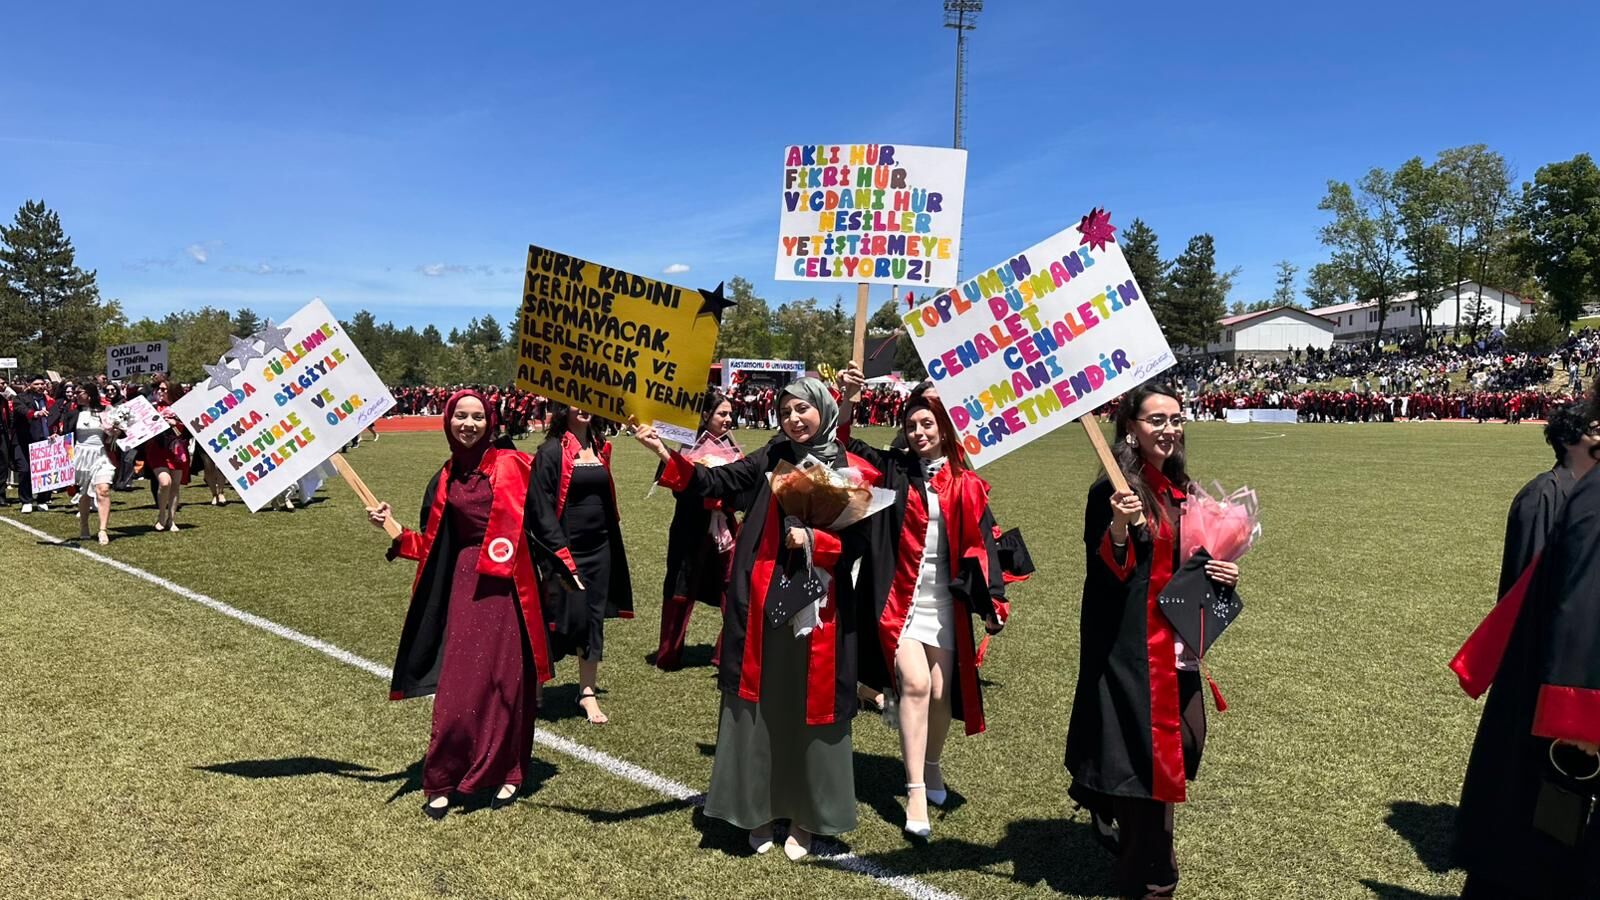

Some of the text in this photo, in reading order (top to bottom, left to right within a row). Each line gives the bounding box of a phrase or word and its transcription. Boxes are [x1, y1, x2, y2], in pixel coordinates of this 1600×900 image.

[786, 144, 899, 166] AKLI HÜR,
[786, 165, 850, 189] FİKRİ
[785, 188, 943, 212] VİCDANI HÜR
[818, 210, 931, 233] NESİLLER
[783, 233, 952, 259] YETİŞTİRMEYE
[794, 256, 931, 283] GELİYORUZ!
[527, 270, 615, 314] YERİNDE
[529, 244, 682, 309] TÜRK KADINI
[904, 254, 1031, 337] TOPLUMUN
[988, 246, 1095, 321] DÜŞMANI
[111, 343, 161, 358] OKUL DA
[523, 315, 677, 381] İLERLEYCEK VE
[524, 294, 670, 357] SAYMAYACAK,
[1003, 279, 1140, 370] CEHALETİN
[112, 363, 163, 377] O KUL DA
[273, 348, 349, 406] BİLGİYLE,
[517, 364, 625, 417] ALACAKTIR
[521, 339, 705, 414] HER SAHADA YERİNİ
[730, 361, 764, 369] KASTAMONU
[190, 382, 256, 433] KADINDA
[949, 355, 1064, 431] DÜŞMANI
[228, 388, 335, 471] KÜLTÜRLE VE
[236, 427, 315, 490] FAZİLETLE
[326, 394, 367, 426] OLUR.
